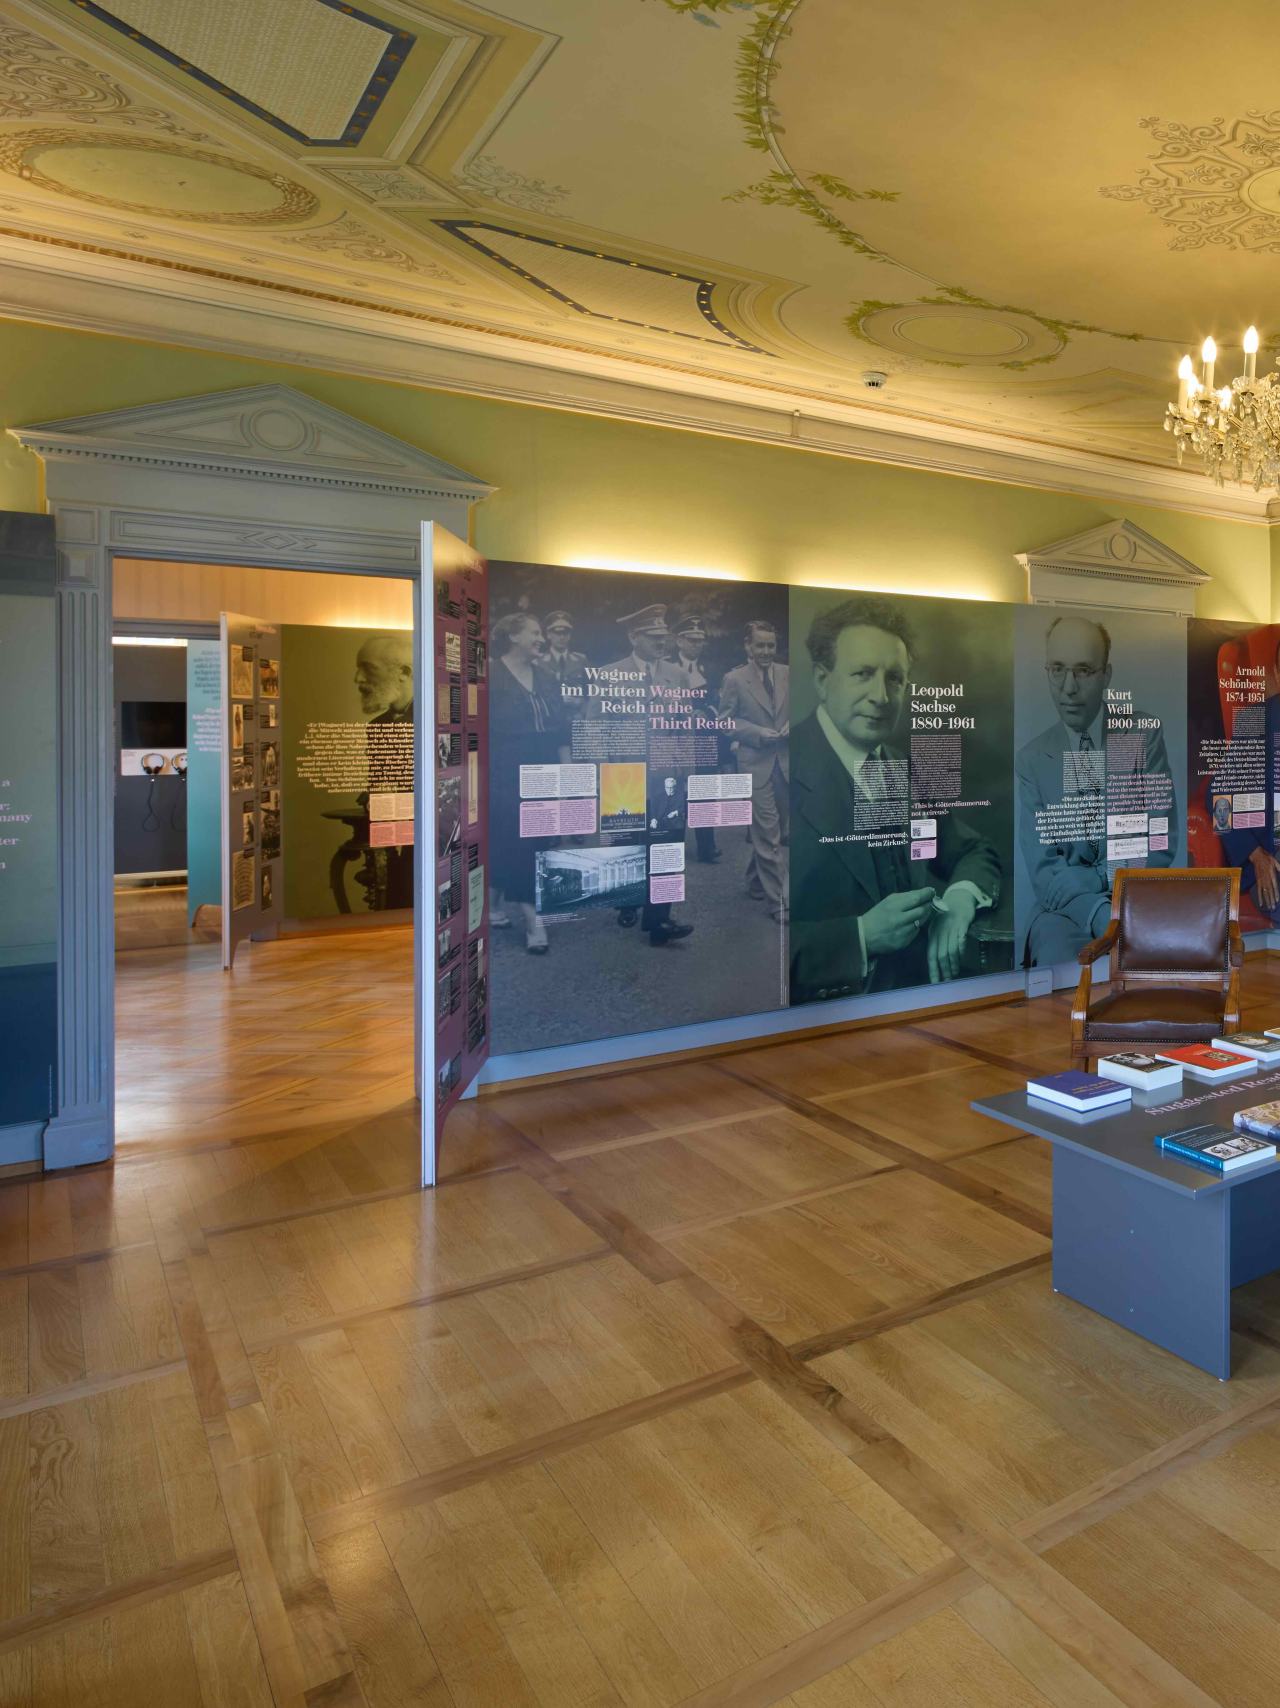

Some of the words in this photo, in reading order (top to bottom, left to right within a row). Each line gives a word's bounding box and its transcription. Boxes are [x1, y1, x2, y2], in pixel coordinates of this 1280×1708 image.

[585, 667, 646, 683] Wagner
[1236, 666, 1265, 676] Arnold
[561, 683, 583, 697] im
[587, 684, 646, 698] Dritten
[911, 683, 964, 699] Leopold
[1219, 678, 1265, 691] Schönberg
[650, 685, 707, 700] Wagner
[1107, 689, 1132, 700] Kurt
[1226, 692, 1265, 702] 1874–1951
[601, 701, 646, 714] Reich
[650, 702, 664, 713] in
[668, 702, 693, 713] the
[911, 700, 956, 713] Sachse
[1107, 704, 1133, 715] Weill
[649, 717, 692, 730] Third
[695, 718, 736, 730] Reich
[911, 717, 976, 729] 1880–1961
[1107, 718, 1160, 729] 1900–1950
[1144, 1085, 1242, 1116] Suggested
